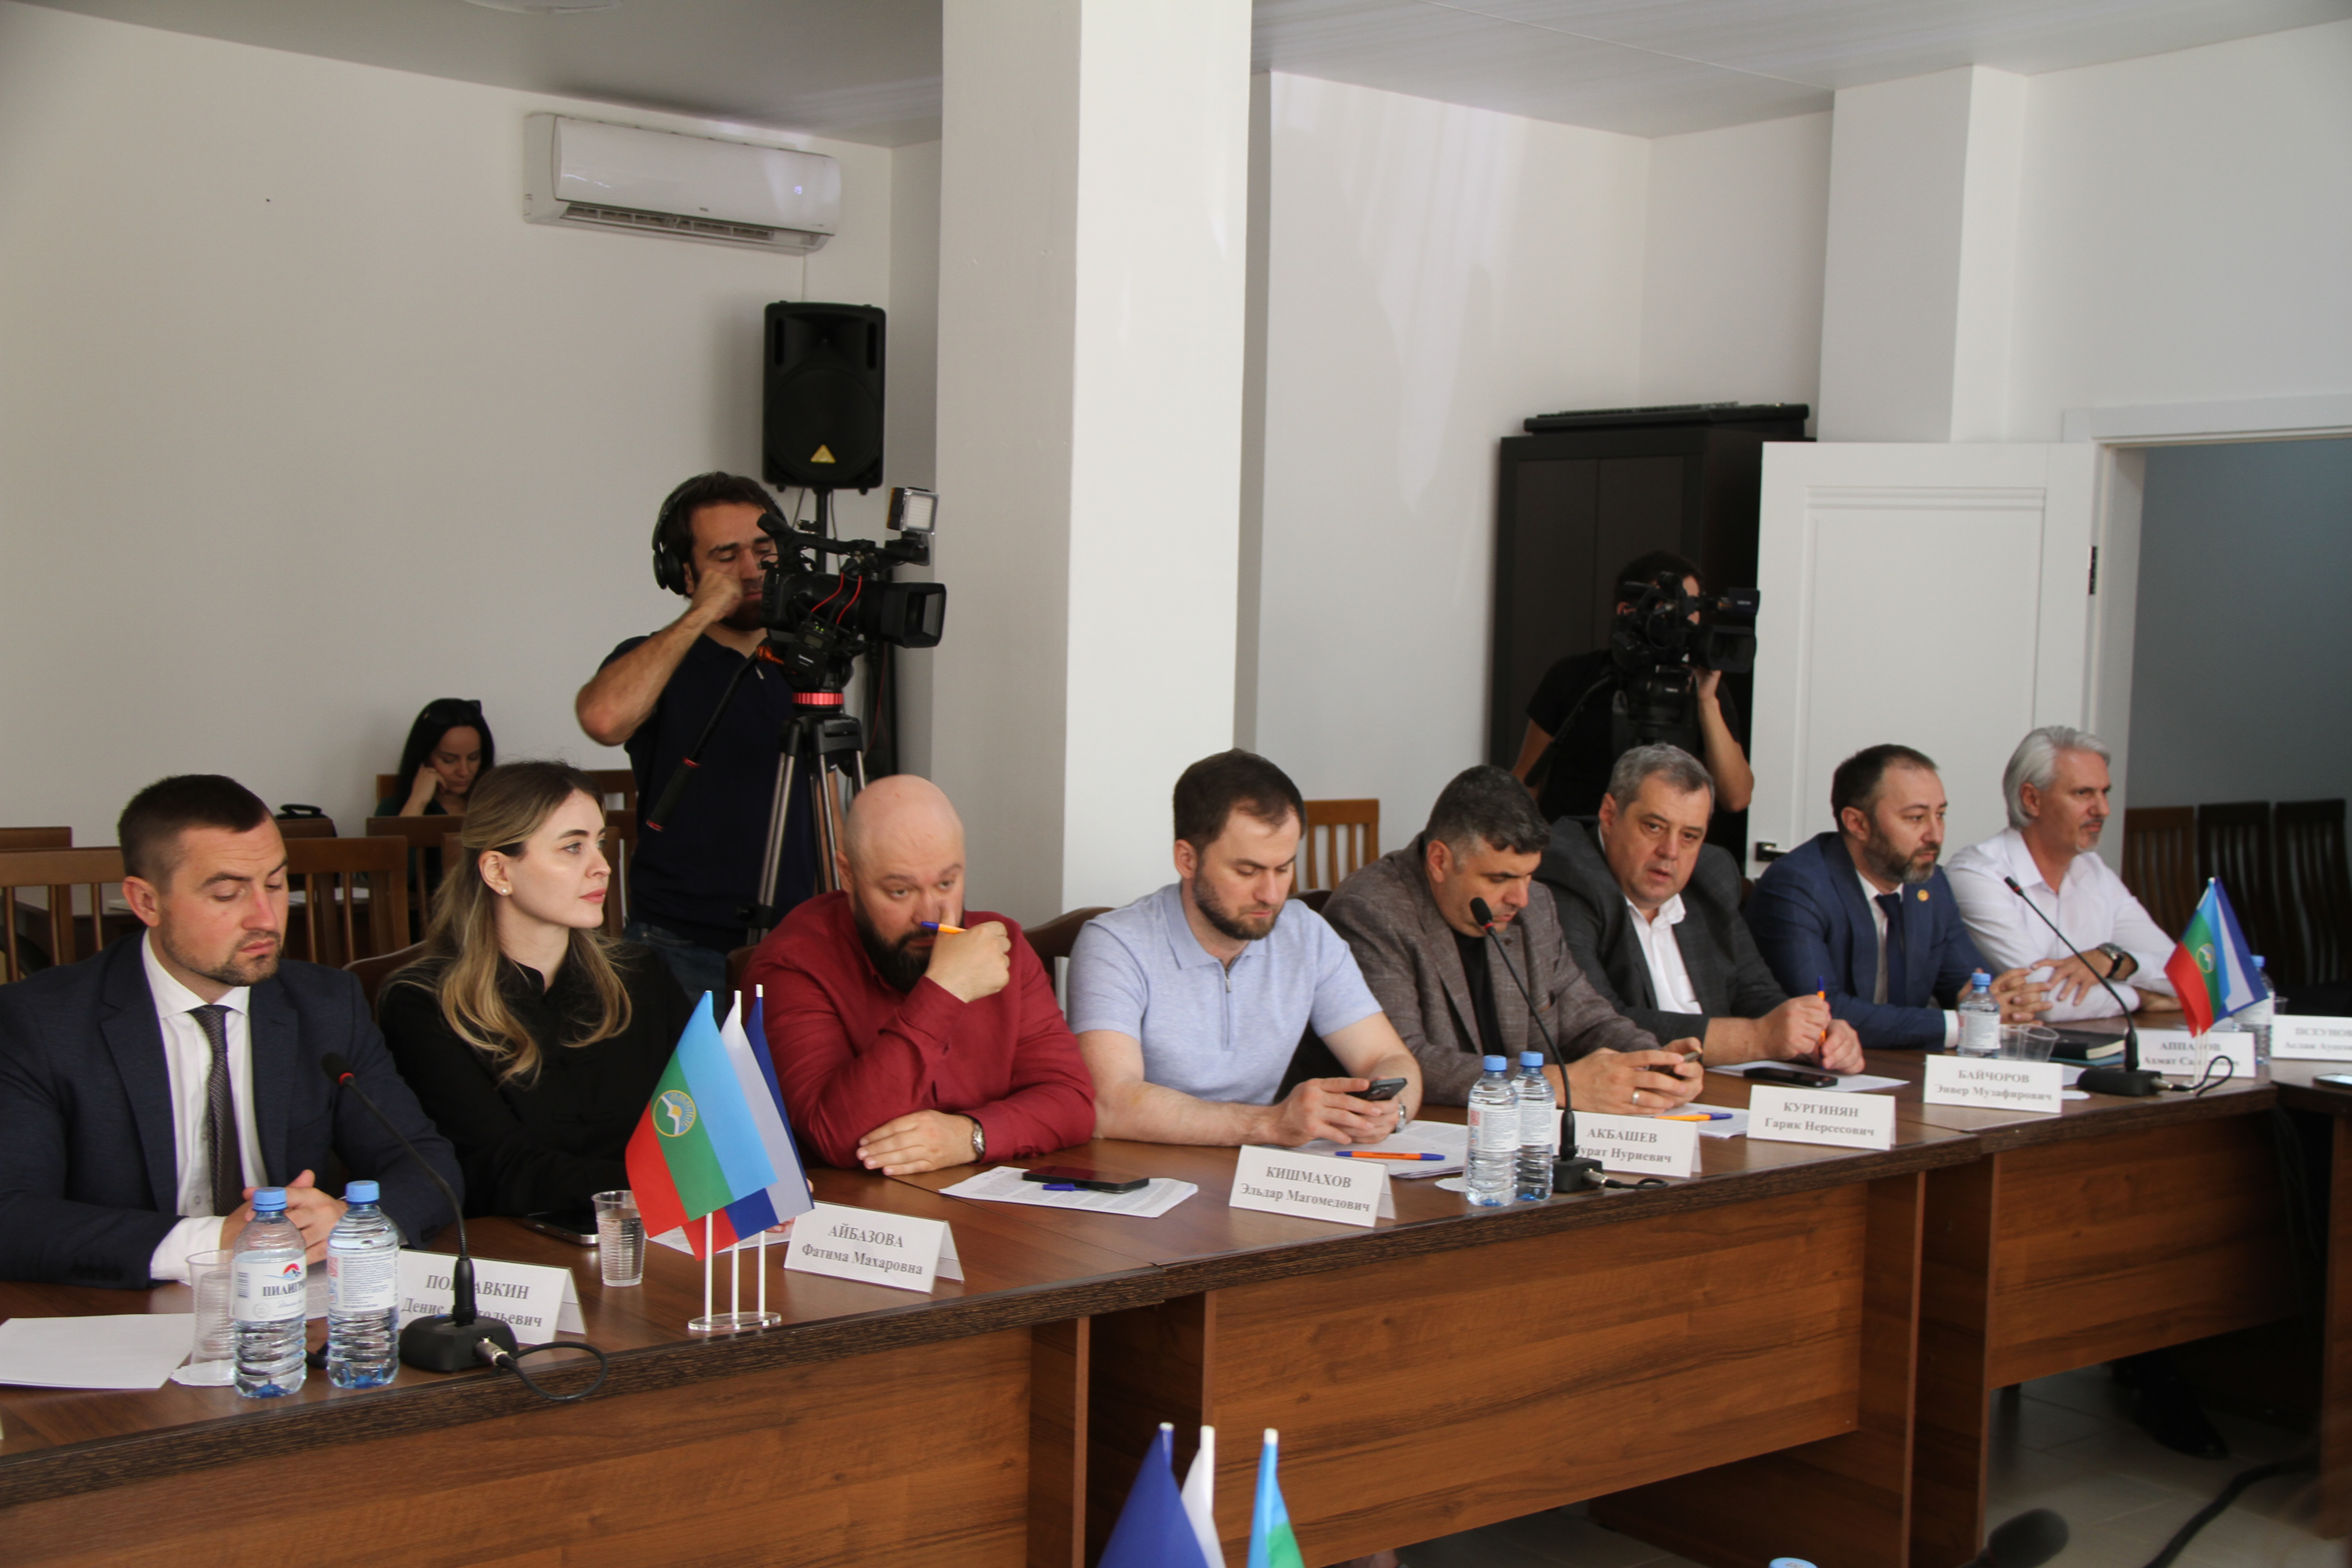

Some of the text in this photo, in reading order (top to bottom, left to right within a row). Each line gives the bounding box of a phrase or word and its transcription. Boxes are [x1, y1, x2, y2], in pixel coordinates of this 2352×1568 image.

[2161, 1042, 2221, 1051] АППАОВ
[1958, 1069, 2029, 1083] БАЙЧОРОВ
[1935, 1084, 1969, 1096] Энвер
[1784, 1102, 1858, 1117] КУРГИНЯН
[1764, 1117, 1874, 1136] Гарик Нерсесович
[1587, 1128, 1657, 1143] АКБАШЕВ
[1611, 1147, 1671, 1162] Нуриевич
[1265, 1166, 1351, 1188] КИШМАХОВ
[1240, 1183, 1370, 1212] Эльдар Магомедович
[828, 1222, 904, 1248] АЙБАЗОВА
[802, 1243, 922, 1274] Фатима Махаровна
[426, 1274, 530, 1299] ПОАВКИН
[401, 1298, 444, 1314] Денис
